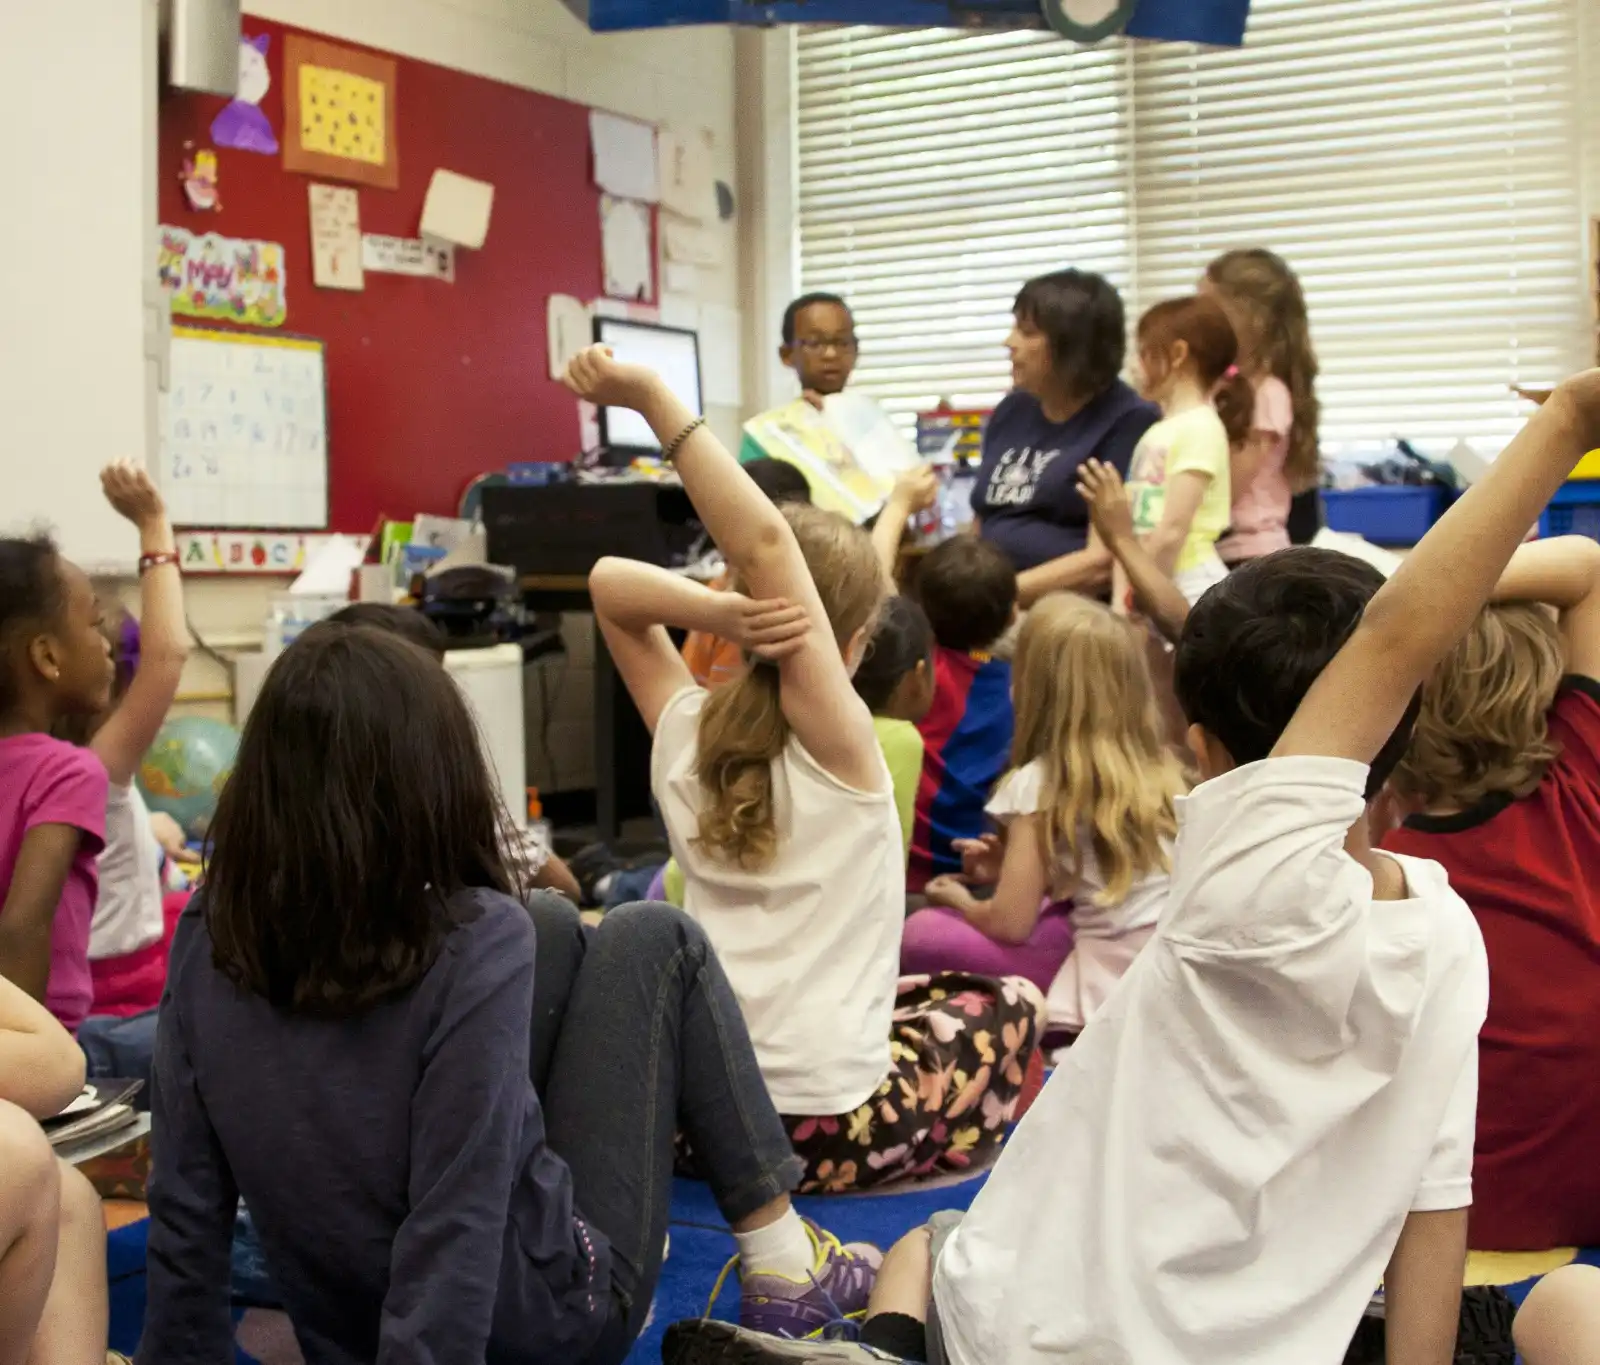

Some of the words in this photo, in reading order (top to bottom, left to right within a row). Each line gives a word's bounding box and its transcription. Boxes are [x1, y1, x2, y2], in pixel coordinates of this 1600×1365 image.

[187, 259, 233, 288] May
[254, 352, 273, 373] 2
[186, 540, 204, 562] A
[273, 542, 288, 563] C
